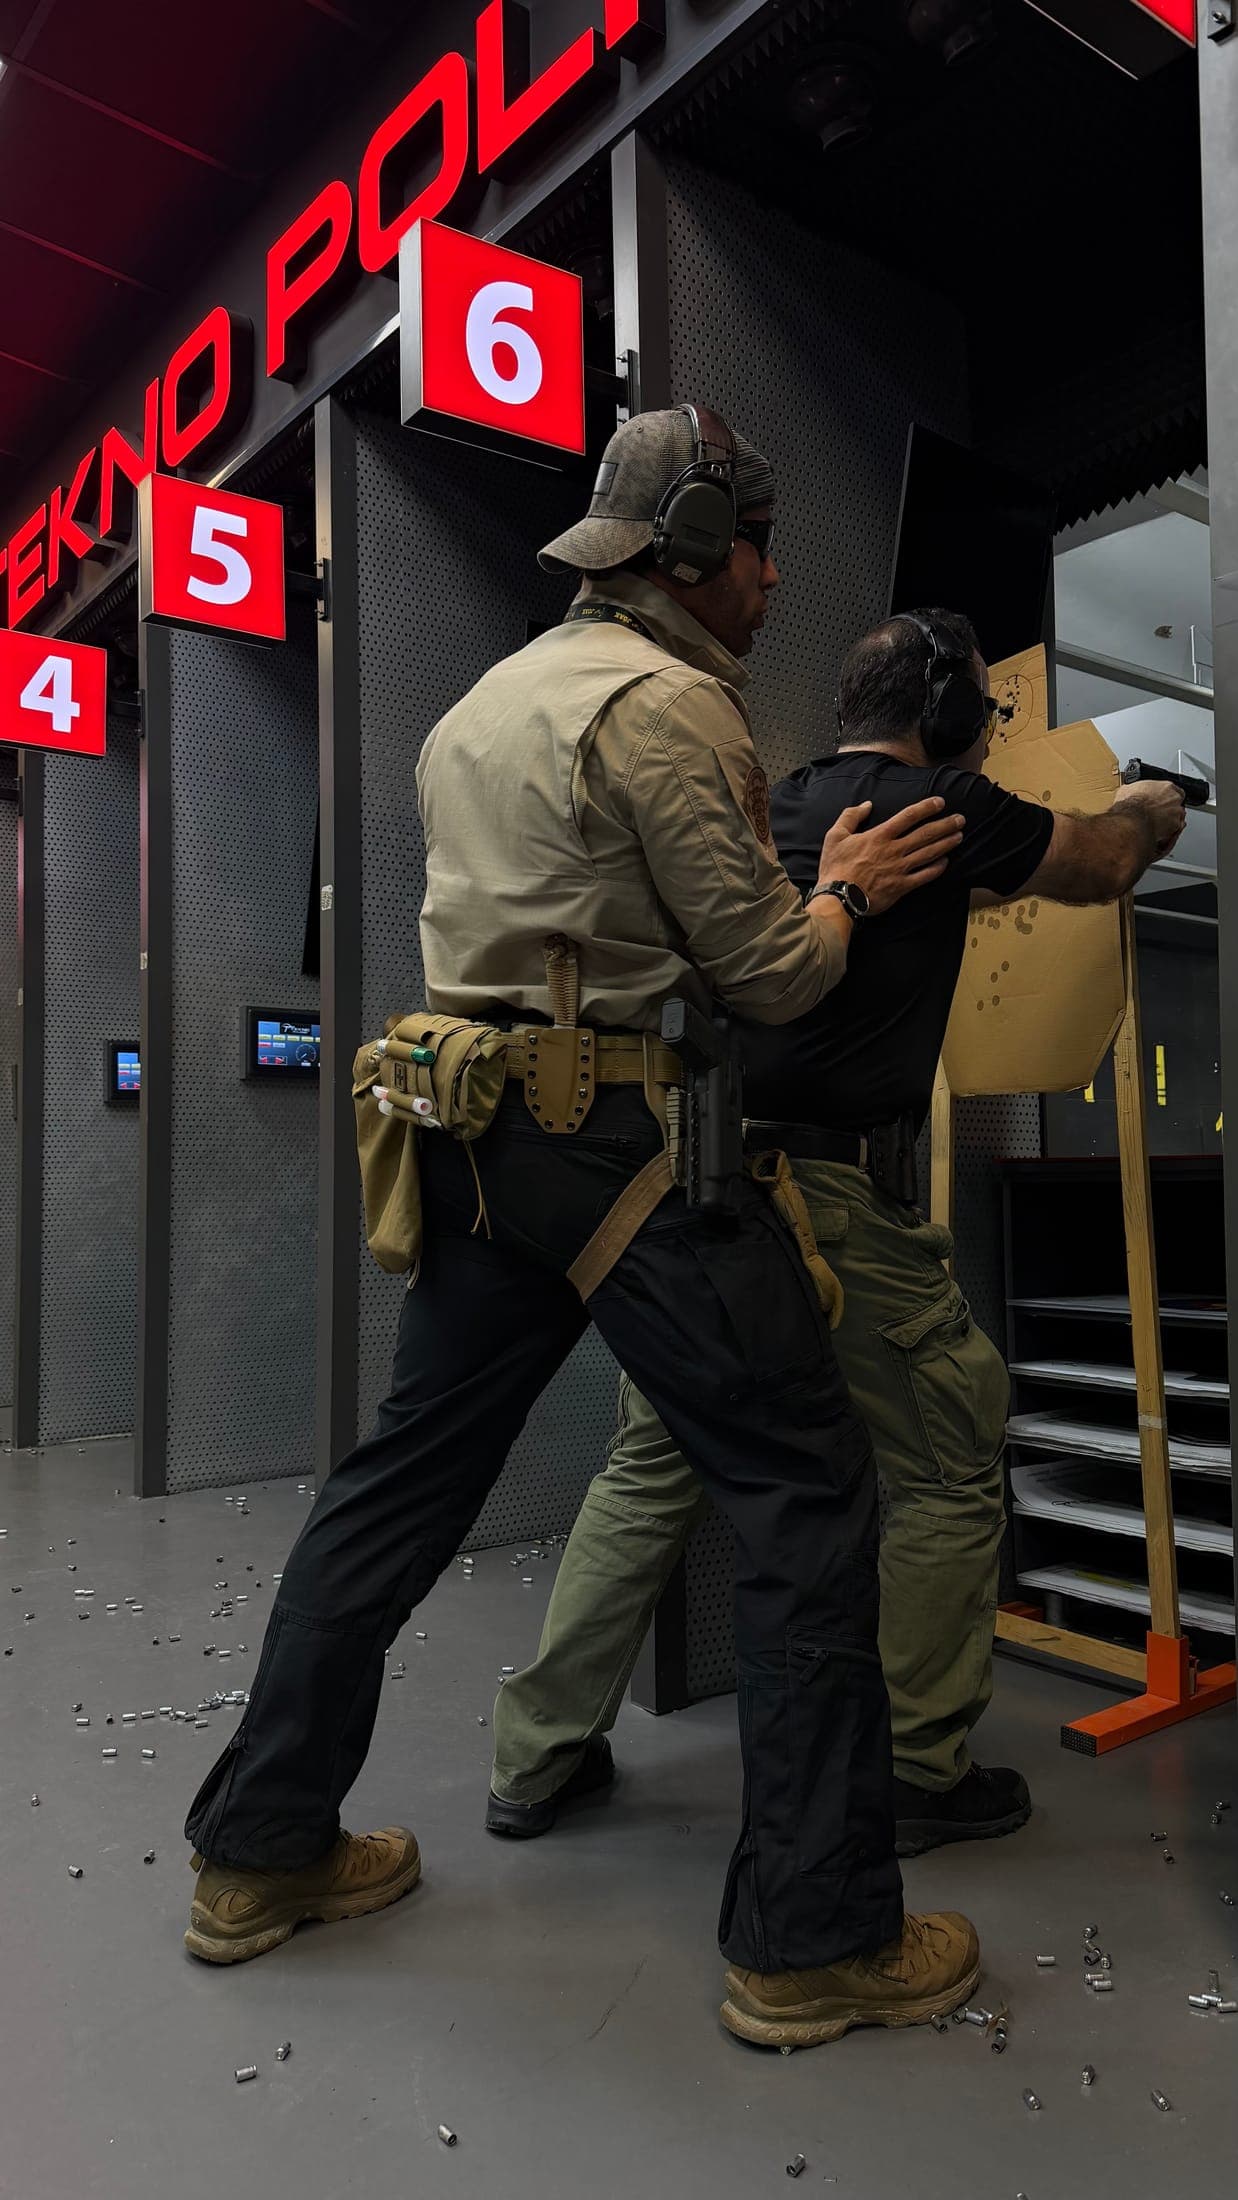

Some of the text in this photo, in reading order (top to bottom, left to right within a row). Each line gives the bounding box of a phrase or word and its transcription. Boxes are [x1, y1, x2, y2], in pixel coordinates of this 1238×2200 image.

[0, 0, 639, 630] EKNO POL
[465, 281, 543, 405] 6
[186, 505, 252, 605] 5
[20, 655, 80, 733] 4
